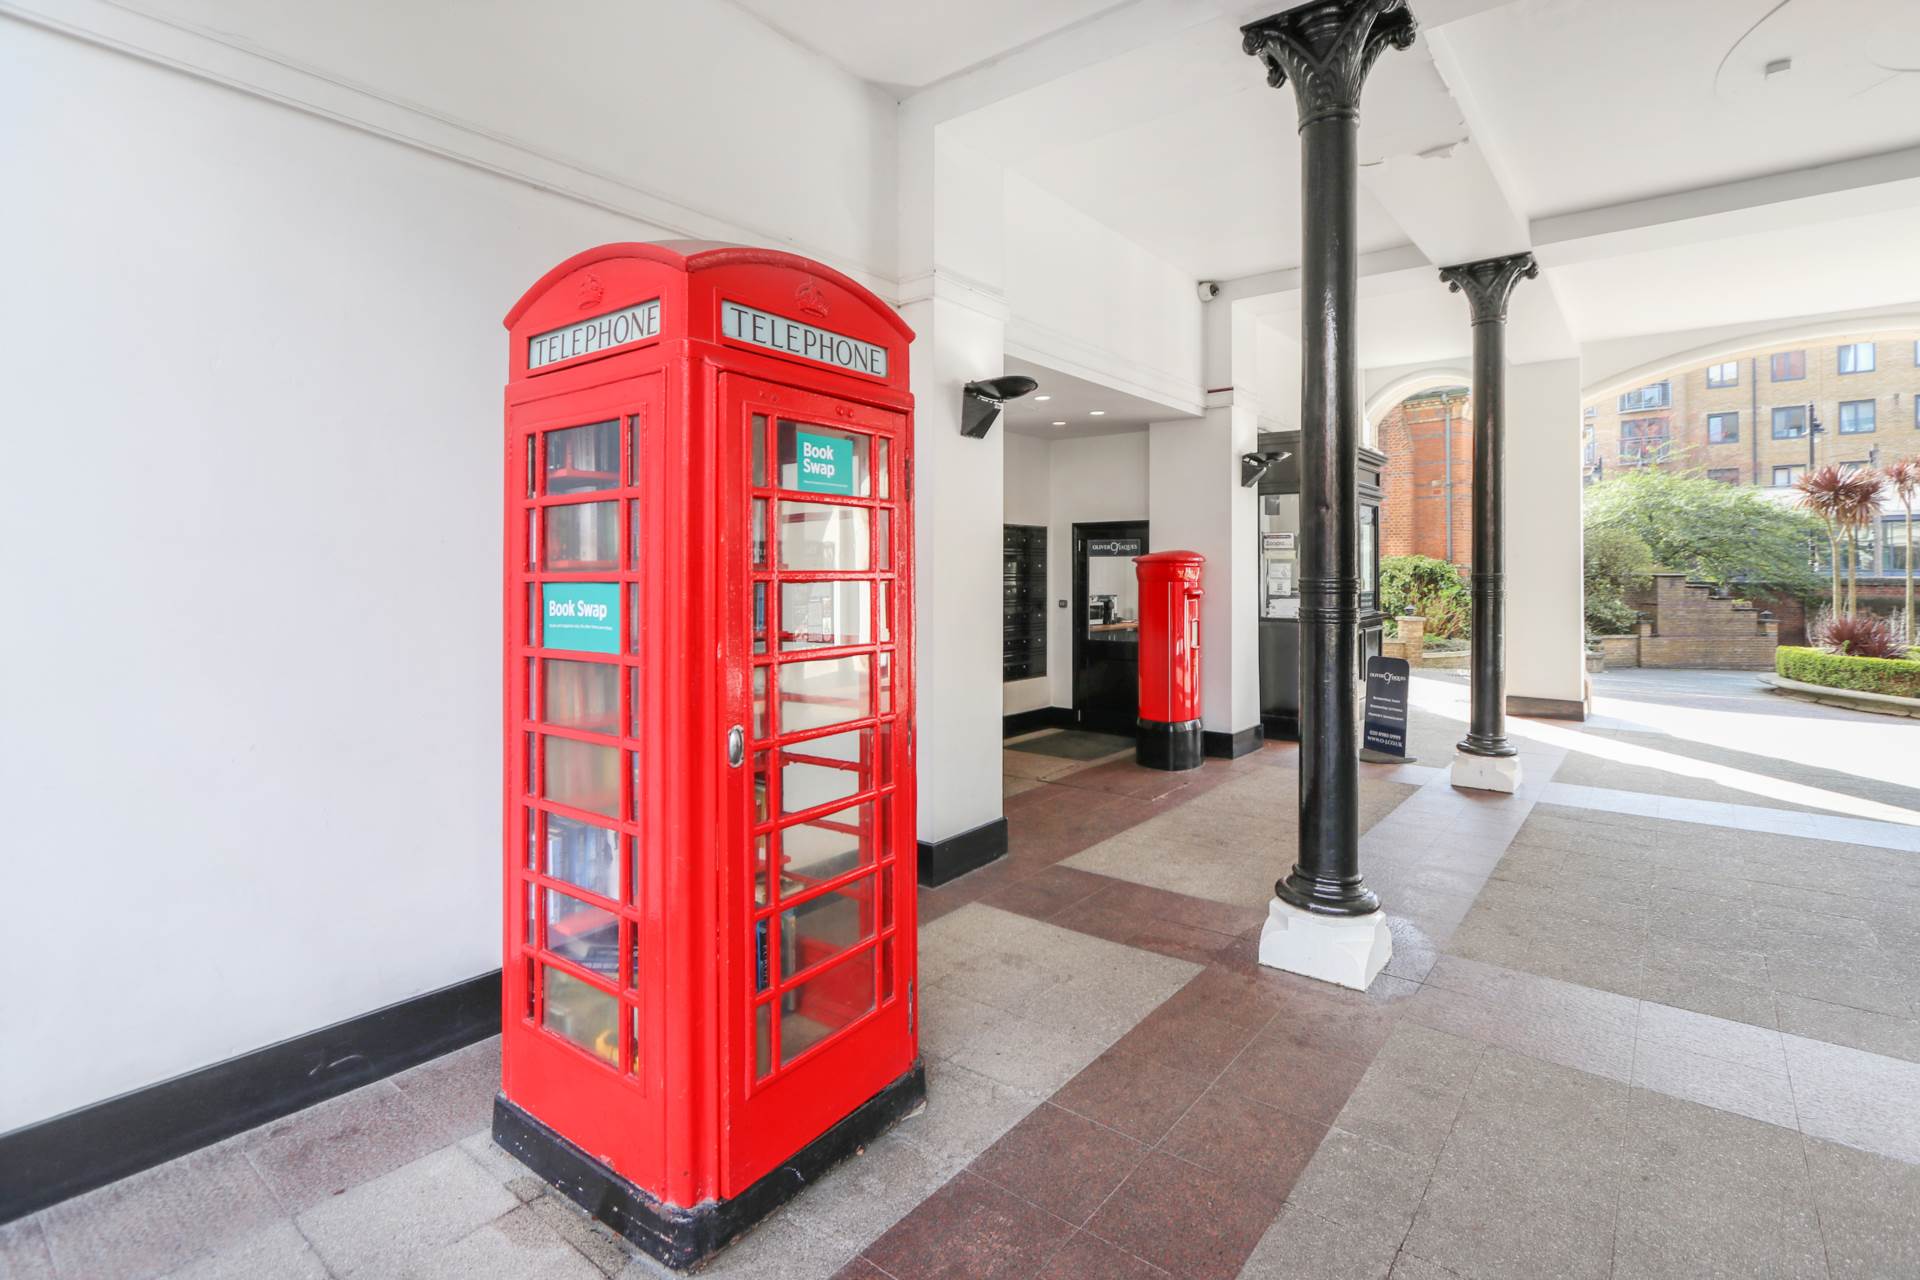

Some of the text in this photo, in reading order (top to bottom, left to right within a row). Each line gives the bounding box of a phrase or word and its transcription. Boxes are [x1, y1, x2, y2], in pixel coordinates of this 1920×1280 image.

[536, 305, 659, 365] TELEPHONE
[730, 307, 881, 375] TELEPHONE
[803, 441, 834, 460] Book
[803, 458, 835, 478] Swap
[548, 599, 608, 621] Book Swap
